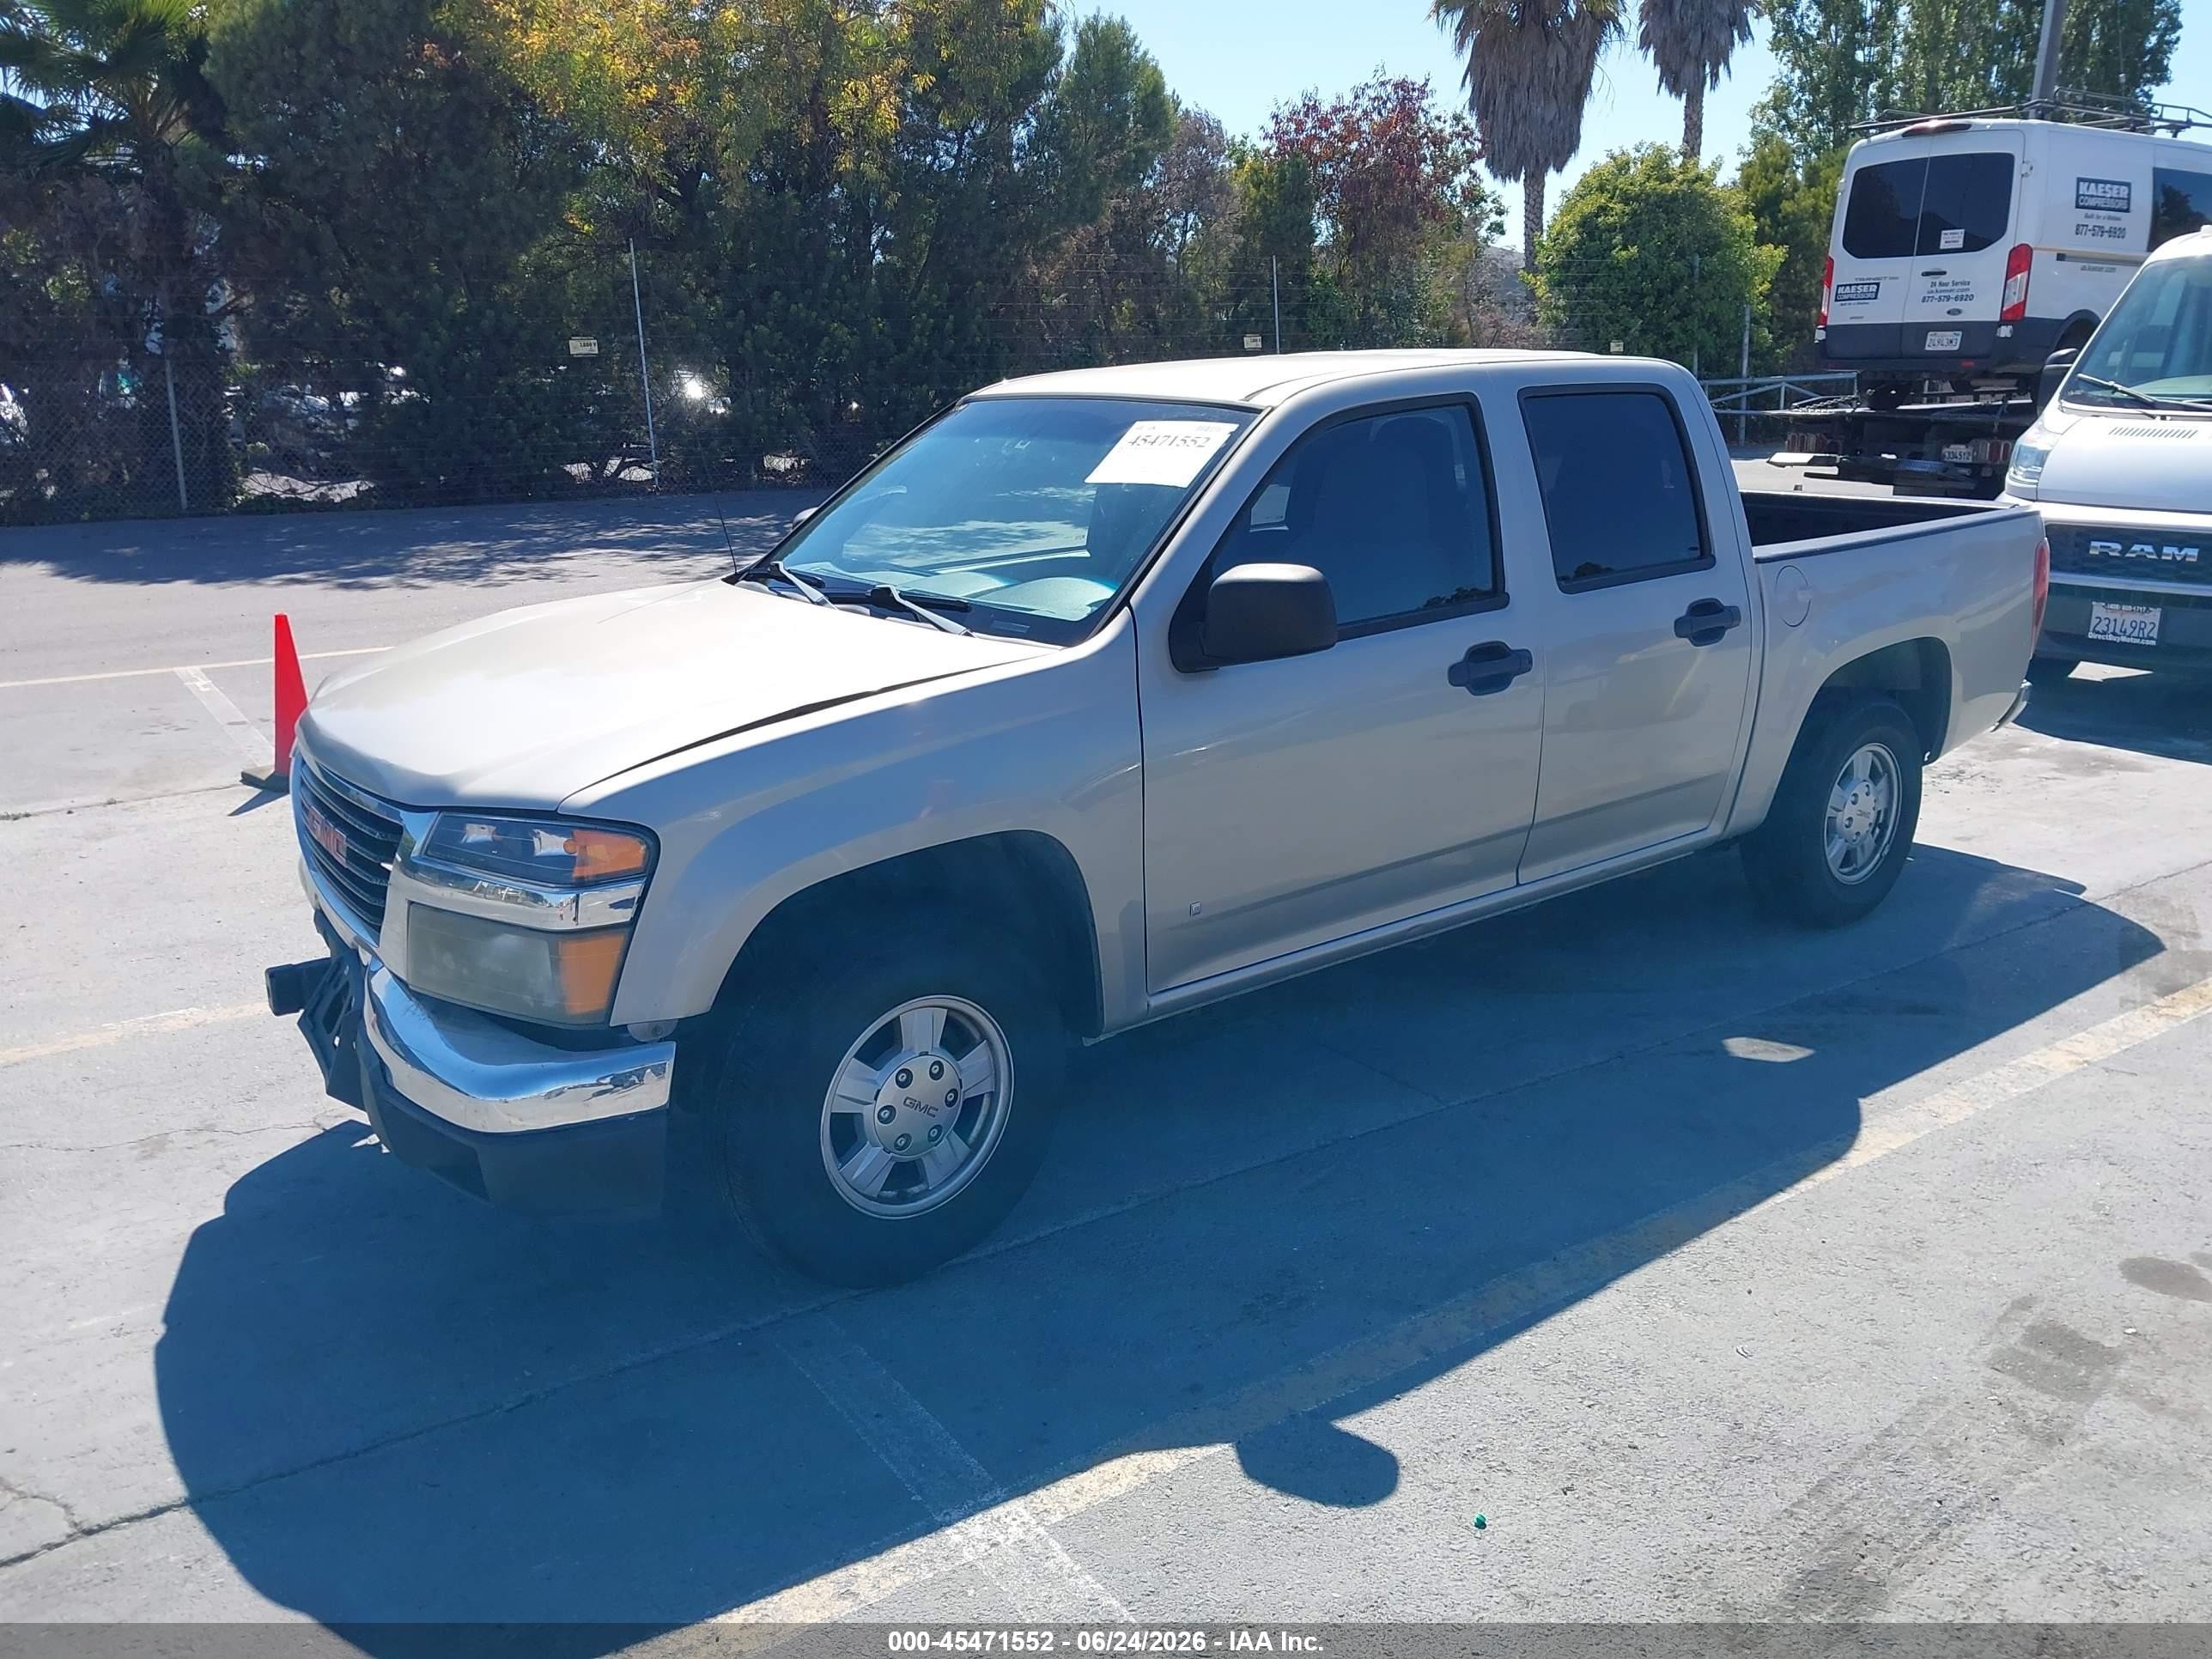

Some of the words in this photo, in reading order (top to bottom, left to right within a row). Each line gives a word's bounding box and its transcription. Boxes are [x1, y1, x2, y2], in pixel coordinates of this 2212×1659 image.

[2079, 181, 2129, 199] KAESER
[2075, 223, 2127, 239] 877-579-6920
[1838, 284, 1878, 295] KAESER
[1951, 279, 1971, 288] Service
[1921, 294, 1974, 303] 877-579-6920
[1128, 434, 1211, 448] 45471552
[2089, 540, 2199, 562] RAM
[2093, 616, 2156, 640] 23149R2
[2088, 631, 2156, 646] DirectBuyMotor.com
[304, 805, 347, 866] GMC
[903, 1096, 939, 1118] GMC
